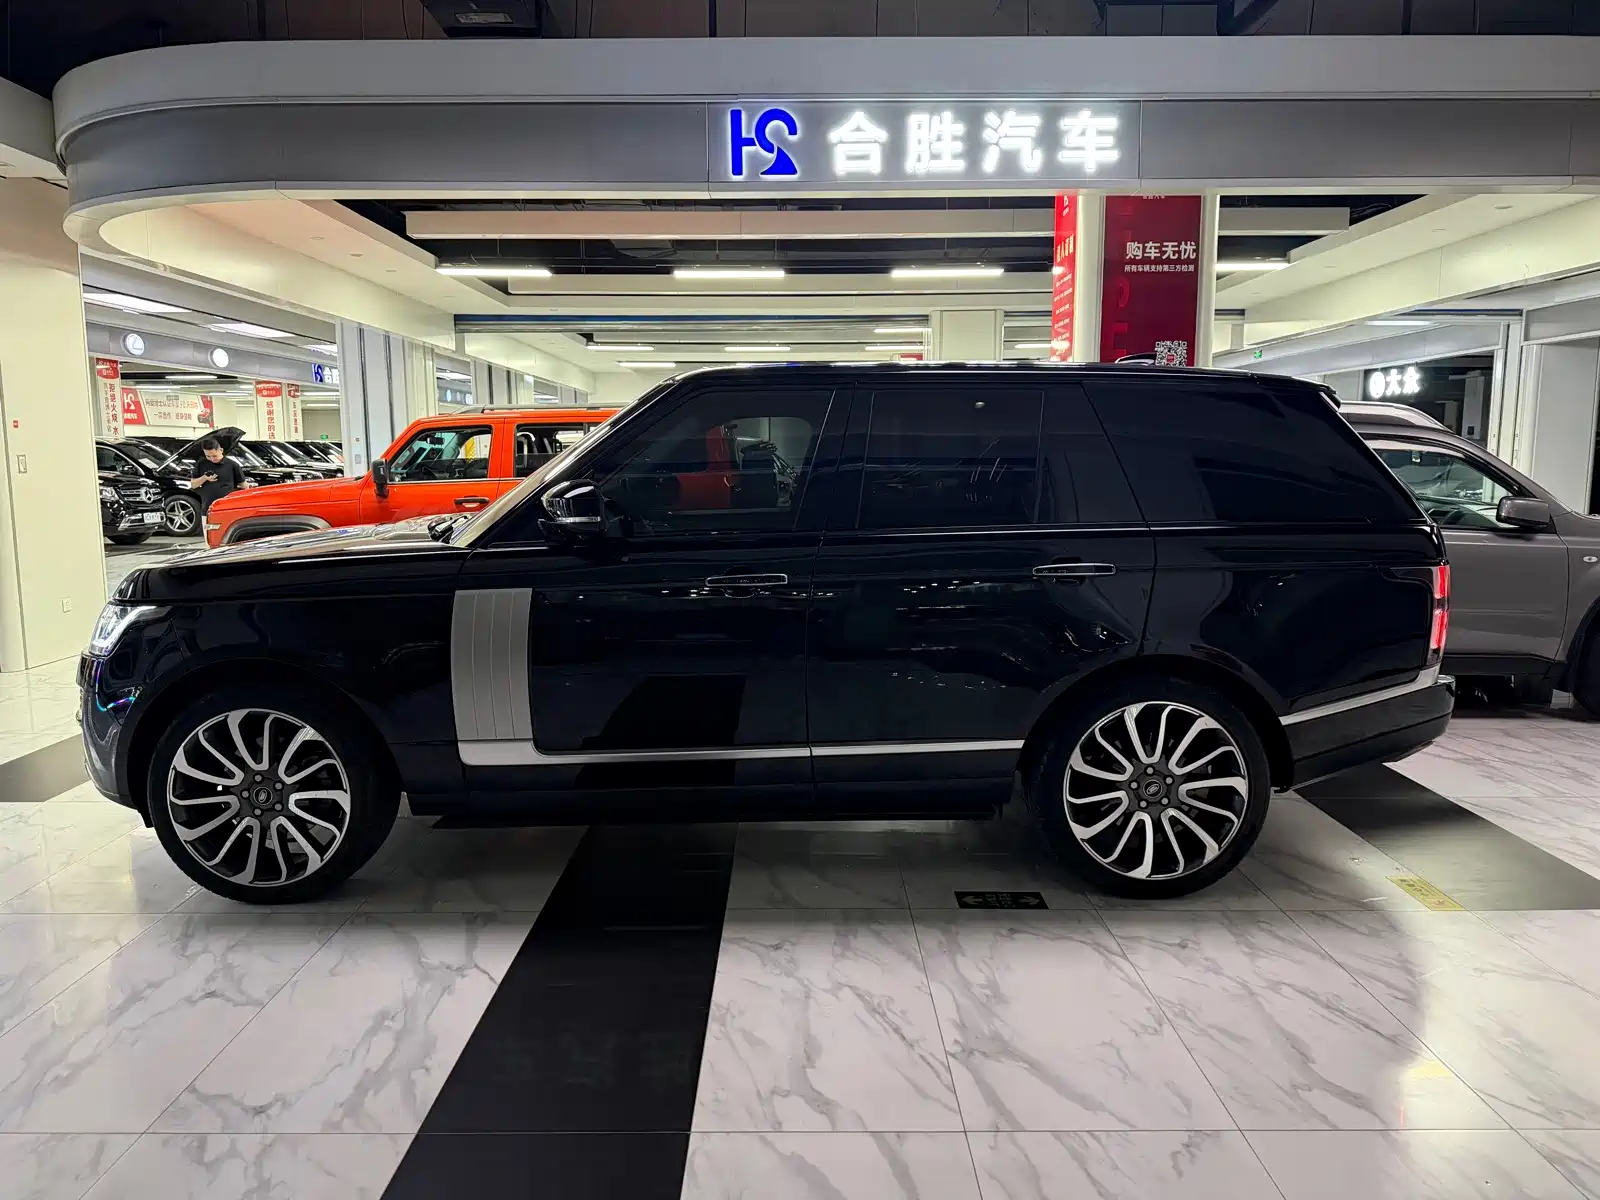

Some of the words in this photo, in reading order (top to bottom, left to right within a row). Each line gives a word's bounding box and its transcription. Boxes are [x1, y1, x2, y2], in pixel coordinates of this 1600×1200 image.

[829, 110, 1120, 174] 合胜汽车
[1125, 241, 1197, 260] 购车无忧
[1124, 264, 1195, 272] 所有车辆支持第三方检测
[1385, 366, 1420, 395] 大众
